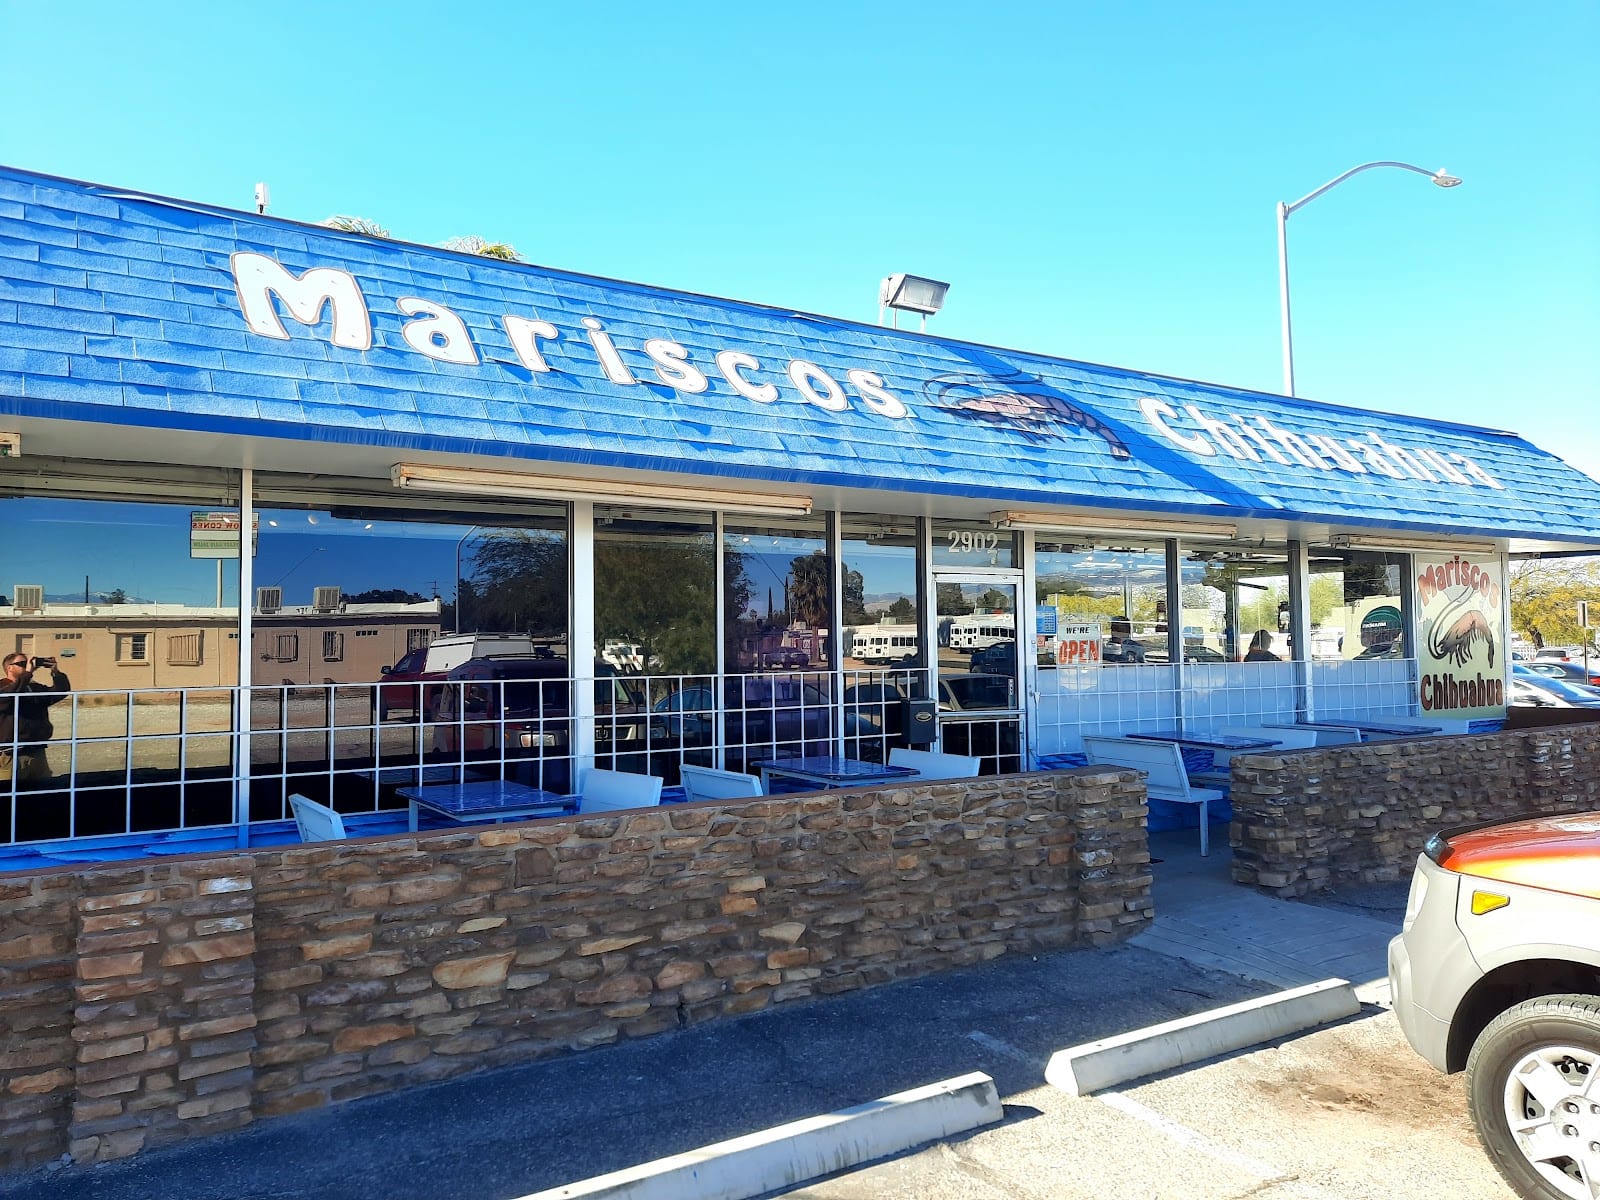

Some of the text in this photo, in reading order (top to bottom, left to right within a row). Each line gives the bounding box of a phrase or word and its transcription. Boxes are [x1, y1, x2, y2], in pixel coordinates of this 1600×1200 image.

[229, 250, 908, 420] Mariscos
[1137, 397, 1506, 490] Chihuahua
[947, 530, 998, 553] 2902
[1418, 555, 1500, 608] Mariscos
[1066, 626, 1090, 634] WE'RE
[1058, 640, 1099, 664] OPEN
[1421, 672, 1503, 711] Chihuahua
